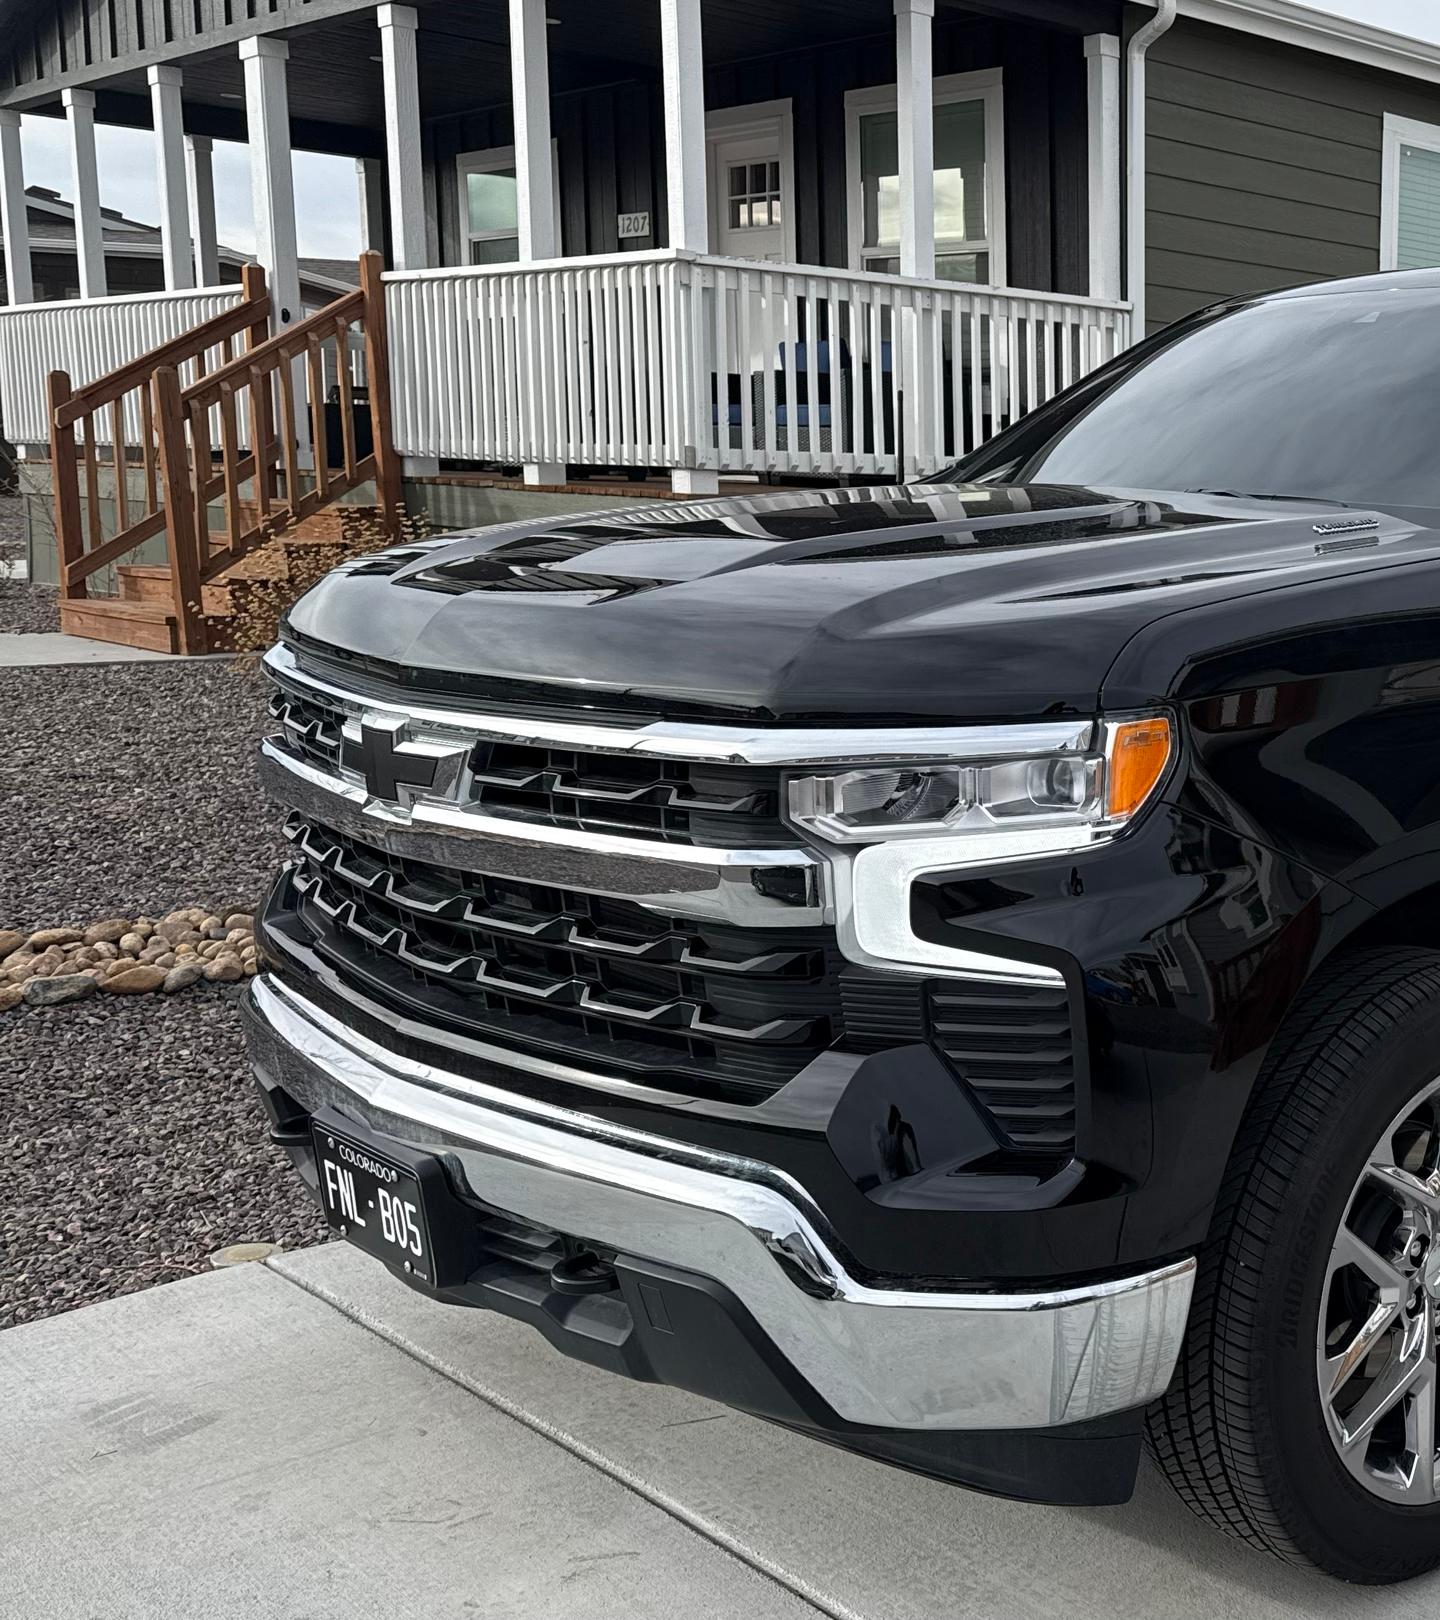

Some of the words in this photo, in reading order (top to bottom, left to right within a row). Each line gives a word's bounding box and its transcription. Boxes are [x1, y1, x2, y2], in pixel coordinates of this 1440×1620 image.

[621, 215, 648, 235] 1207
[339, 1144, 392, 1183] COLORADO
[1275, 1162, 1340, 1351] BRIDGESTONE
